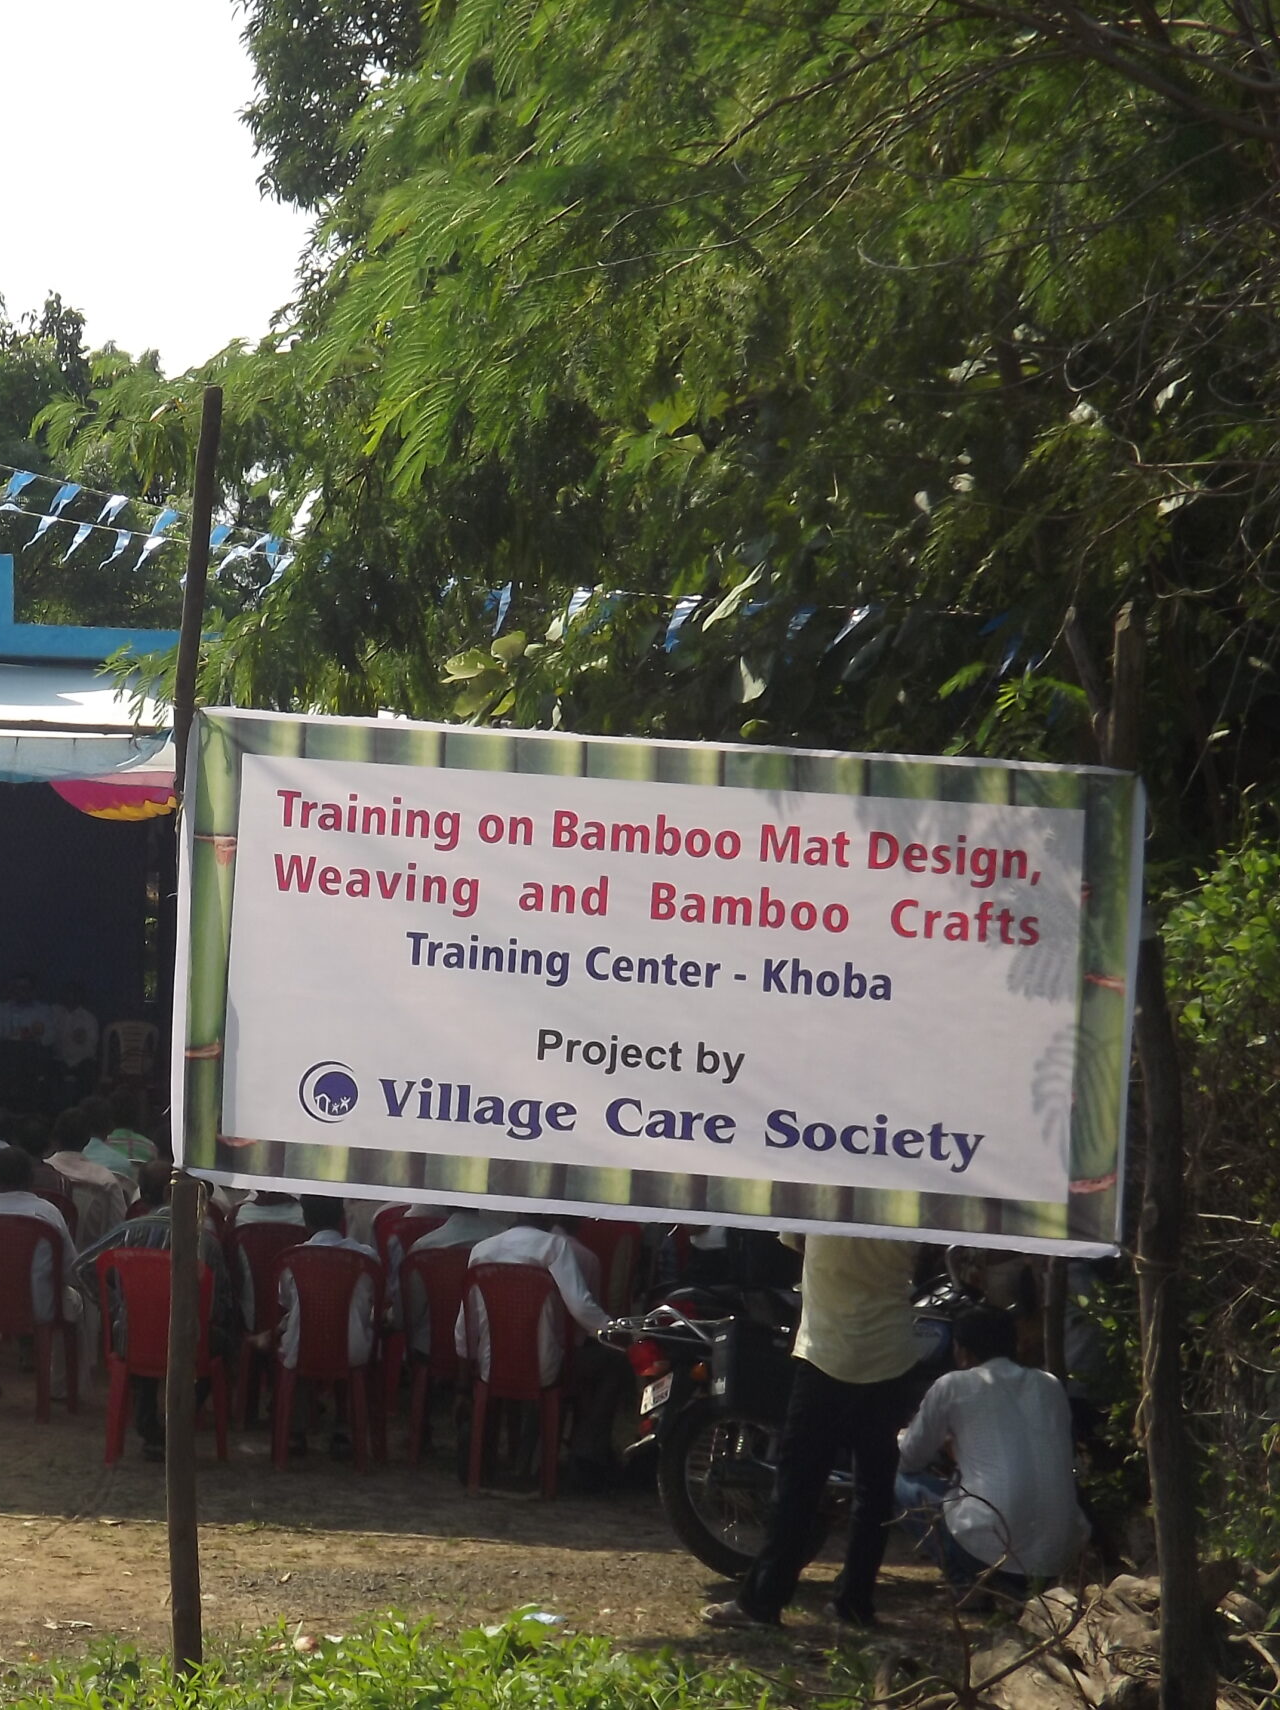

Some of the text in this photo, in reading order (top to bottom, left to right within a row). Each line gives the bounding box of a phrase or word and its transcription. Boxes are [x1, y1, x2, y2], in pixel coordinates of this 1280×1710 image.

[275, 789, 1042, 889] Training on Bamboo Mat Design,
[273, 853, 1041, 946] Weaving and Bamboo Crafts
[406, 931, 570, 988] Training
[585, 946, 722, 989] Center
[762, 958, 893, 1001] Khoba
[537, 1028, 746, 1085] Project by
[377, 1078, 986, 1174] Village Care Society
